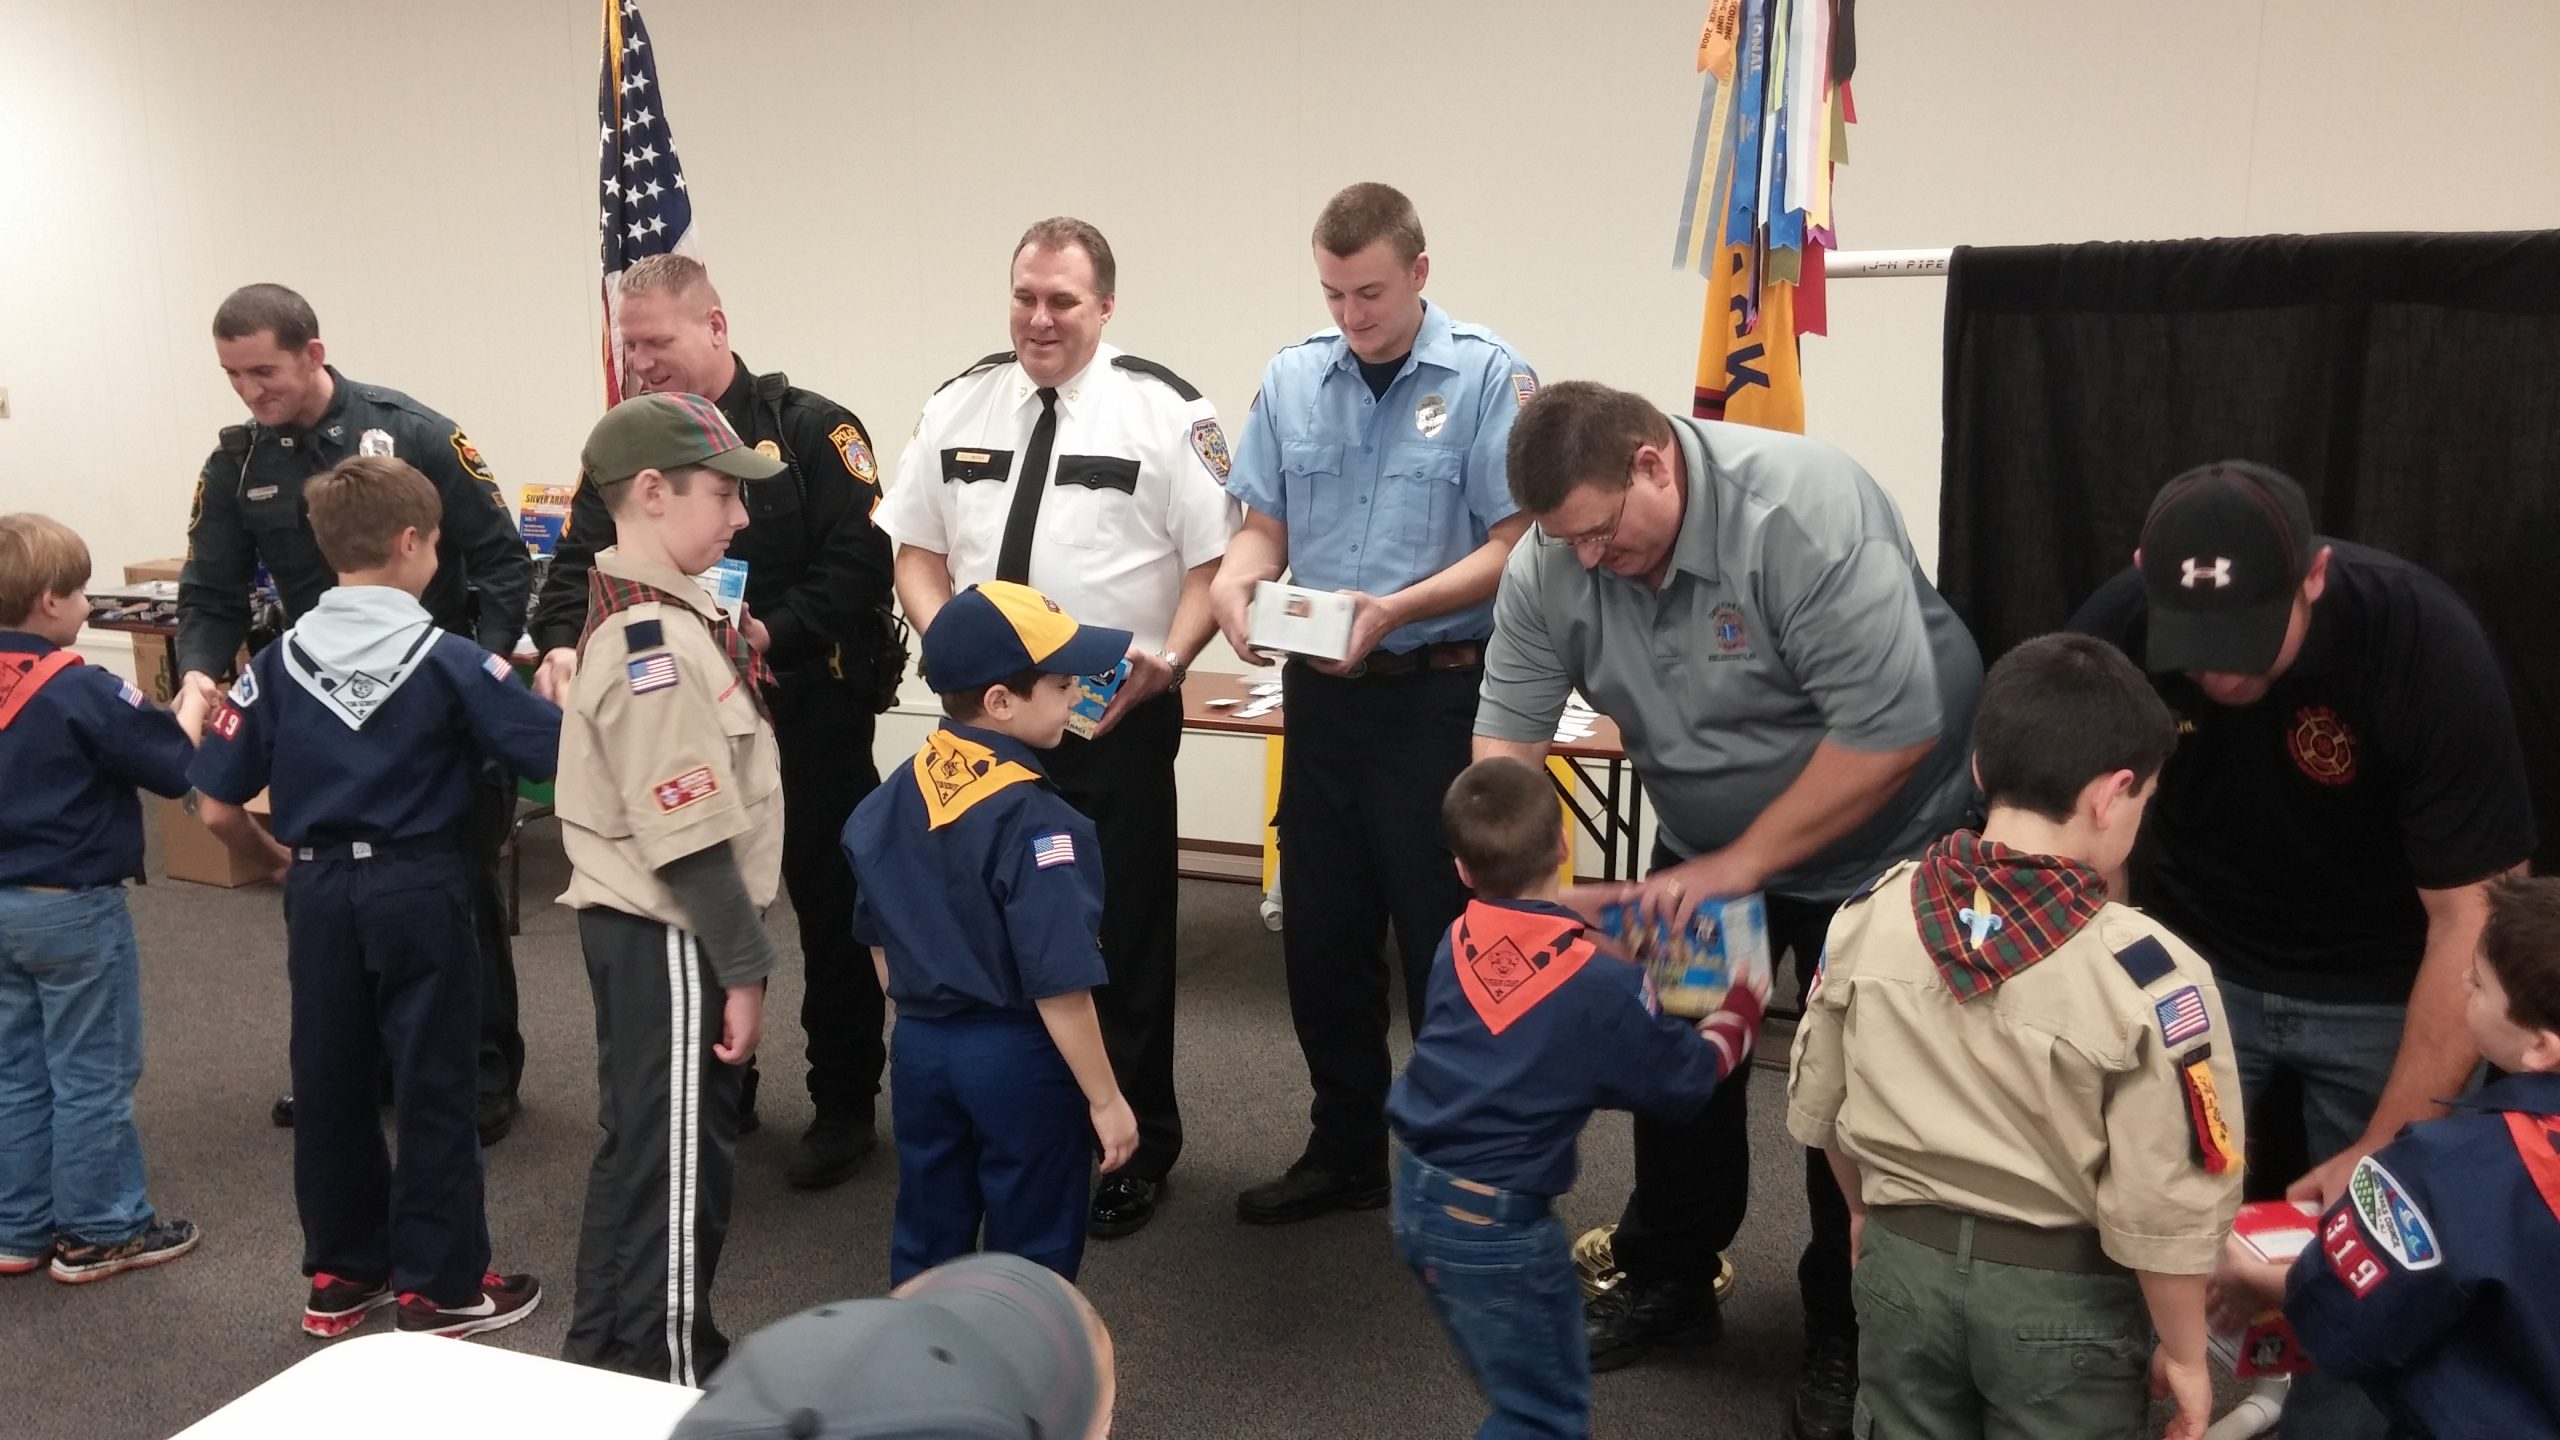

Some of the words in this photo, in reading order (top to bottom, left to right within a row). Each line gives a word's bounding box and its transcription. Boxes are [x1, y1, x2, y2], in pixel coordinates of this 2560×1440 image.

[1716, 16, 1725, 35] UNIT
[1724, 1, 1737, 41] SCOUTING
[1906, 259, 1945, 270] PIPE
[525, 494, 549, 504] SILVER
[549, 495, 572, 505] ARRO
[2384, 1217, 2401, 1248] COUNCIL
[2326, 1213, 2379, 1289] 319
